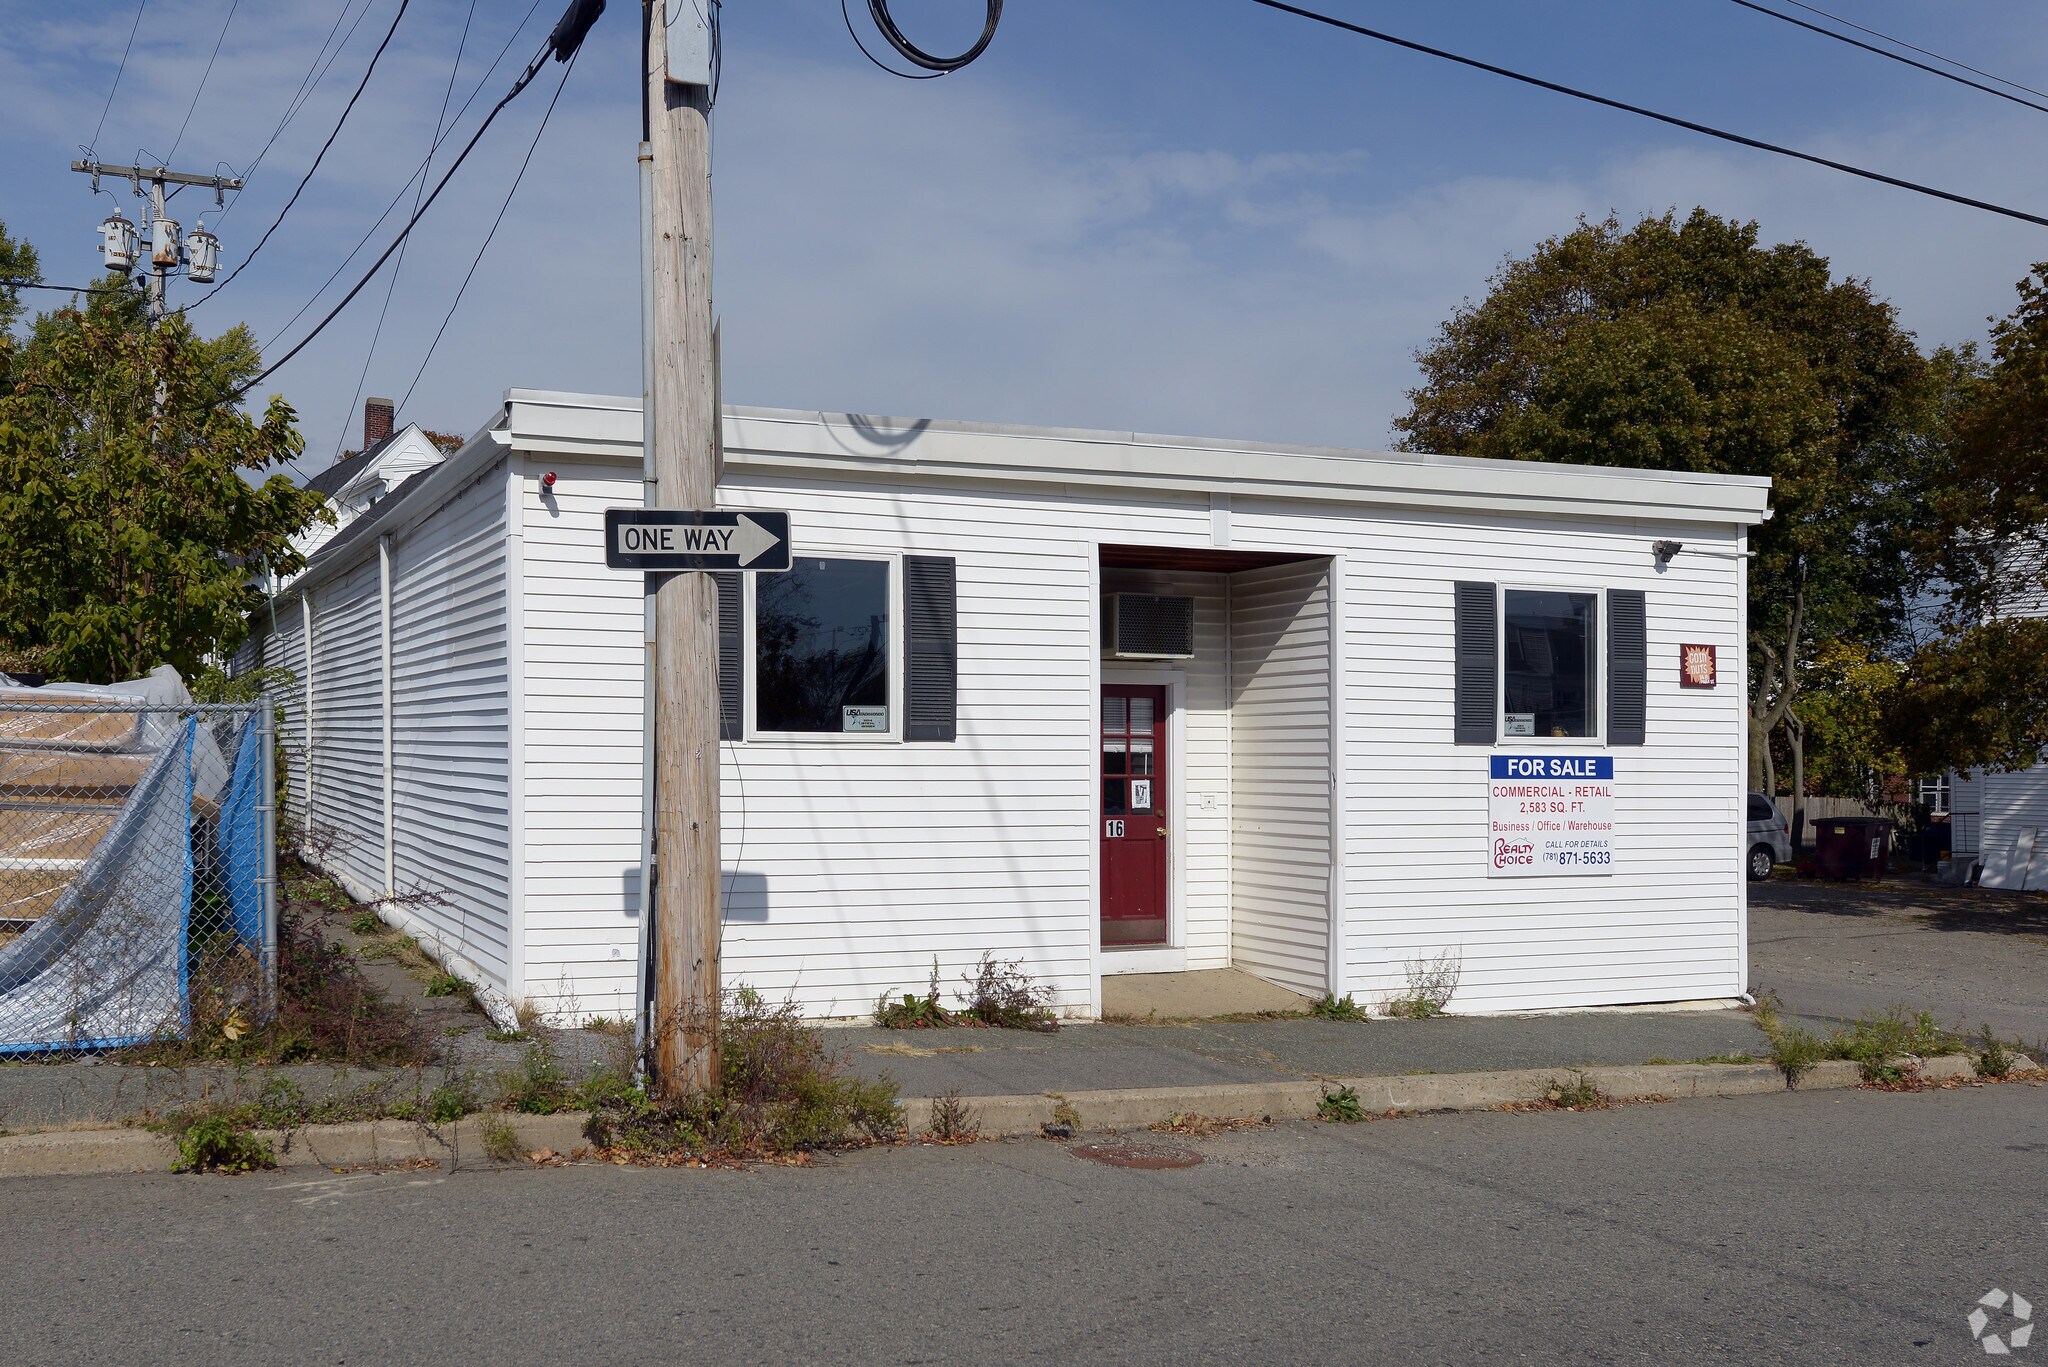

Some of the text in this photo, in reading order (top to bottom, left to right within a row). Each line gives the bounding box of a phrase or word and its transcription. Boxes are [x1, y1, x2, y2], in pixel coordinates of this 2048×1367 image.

[625, 528, 734, 551] ONE WAY
[1507, 759, 1596, 776] FOR SALE
[1492, 786, 1565, 798] COMMERCIAL
[1575, 786, 1611, 797] RETAIL
[1519, 802, 1585, 814] 2,583 SQ. FT.
[1109, 821, 1123, 837] 16
[1492, 821, 1530, 832] Business
[1537, 820, 1561, 831] Office
[1568, 820, 1612, 831] Warehouse
[1494, 837, 1535, 855] REALTY
[1545, 840, 1608, 848] CALL FOR DETAILS
[1494, 854, 1533, 868] CHOICE
